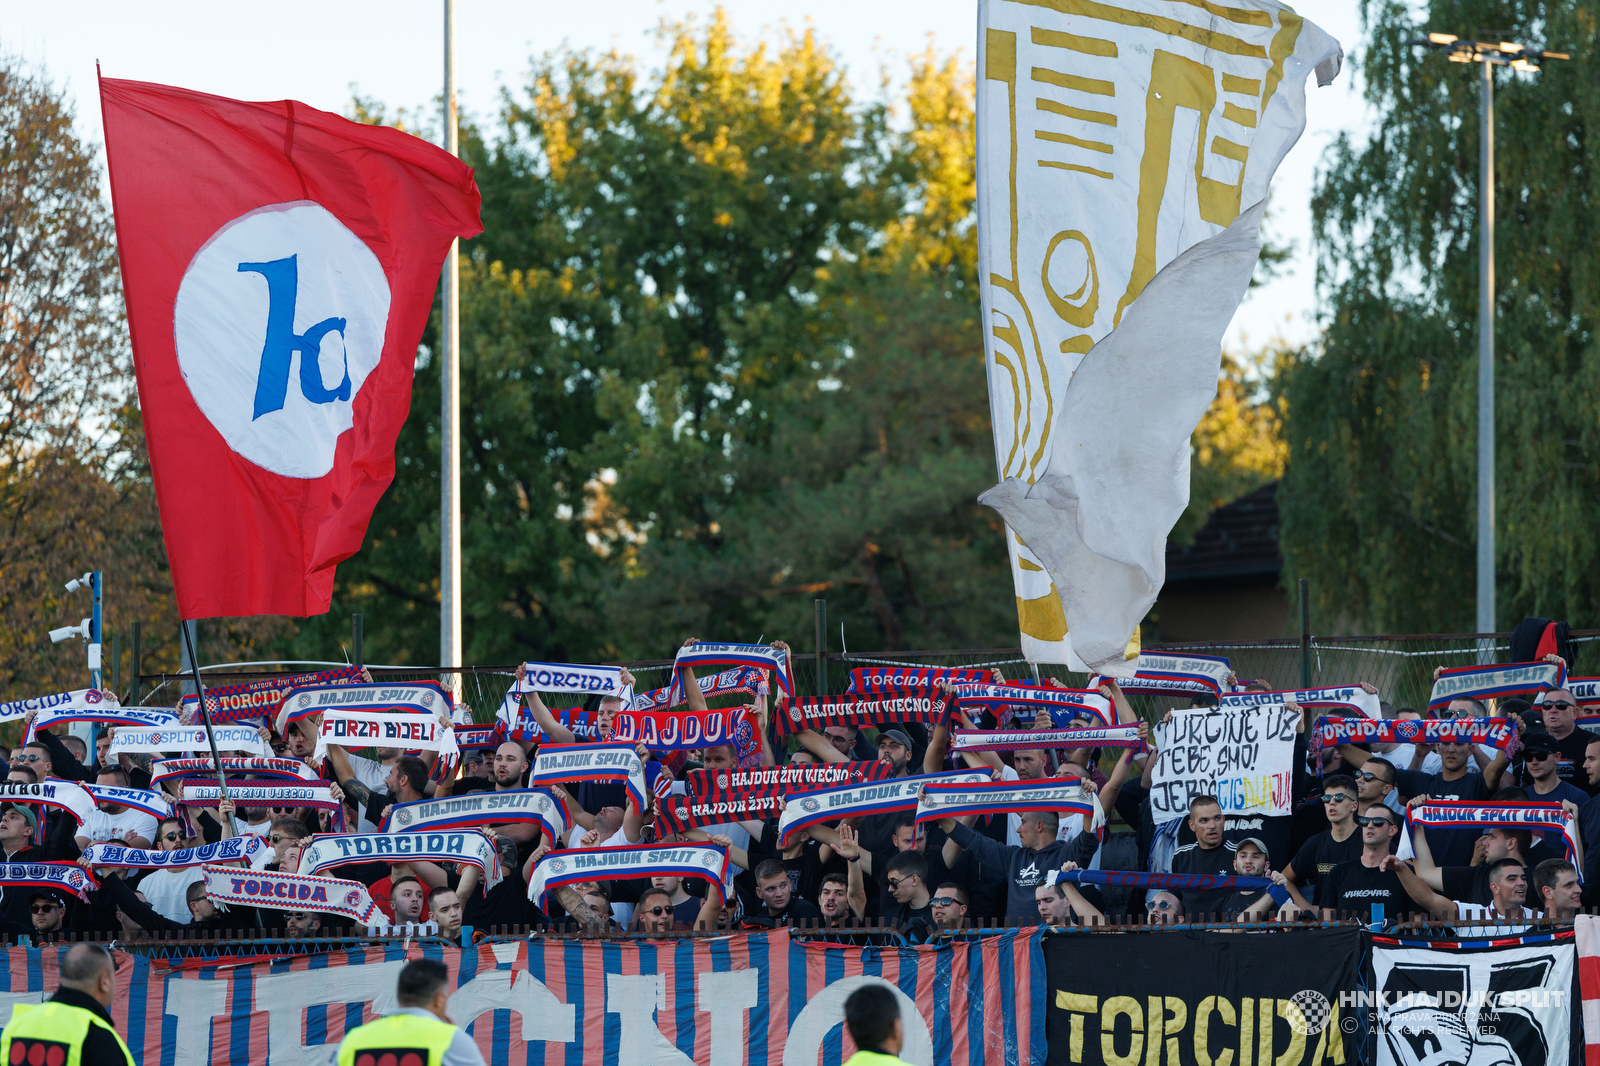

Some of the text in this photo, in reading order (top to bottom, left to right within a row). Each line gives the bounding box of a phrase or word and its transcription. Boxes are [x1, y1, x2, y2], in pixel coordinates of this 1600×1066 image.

[1180, 660, 1221, 674] SPLIT
[525, 670, 616, 691] TORCIDA
[863, 674, 929, 687] TORCIDA
[1436, 666, 1549, 695] HAJDUK SPLIT
[318, 689, 419, 705] HAJDUK SPLIT
[802, 696, 931, 719] HAJDUK ŽIVI VJEČNO
[322, 719, 379, 738] FORZA
[571, 717, 598, 738] živi
[615, 706, 748, 747] HAJDUK
[1424, 721, 1513, 741] KONAVLE
[160, 731, 196, 744] SPLIT
[161, 758, 210, 773] HAJDUK
[250, 757, 301, 775] ULTRAS
[540, 752, 632, 771] HAJDUK SPLIT
[1156, 743, 1260, 777] TEBE SMO!
[731, 766, 849, 787] HAJDUK ŽIVI VJEČNO
[107, 787, 154, 804] SPLIT
[419, 794, 534, 818] HAJDUK SPLIT
[691, 798, 747, 818] HAJDUK
[747, 794, 775, 813] ŽIVI
[828, 784, 901, 808] HAJDUK
[945, 789, 1070, 805] HAJDUK SPLIT
[1422, 807, 1475, 821] HAJDUK
[1480, 808, 1520, 822] SPLIT
[100, 837, 243, 865] HAJDUK
[335, 834, 465, 856] TORCIDA
[573, 850, 697, 869] HAJDUK SPLIT
[230, 877, 328, 902] TORCIDA
[1102, 869, 1238, 892] TORCIDA
[1055, 989, 1347, 1066] TORCIDA
